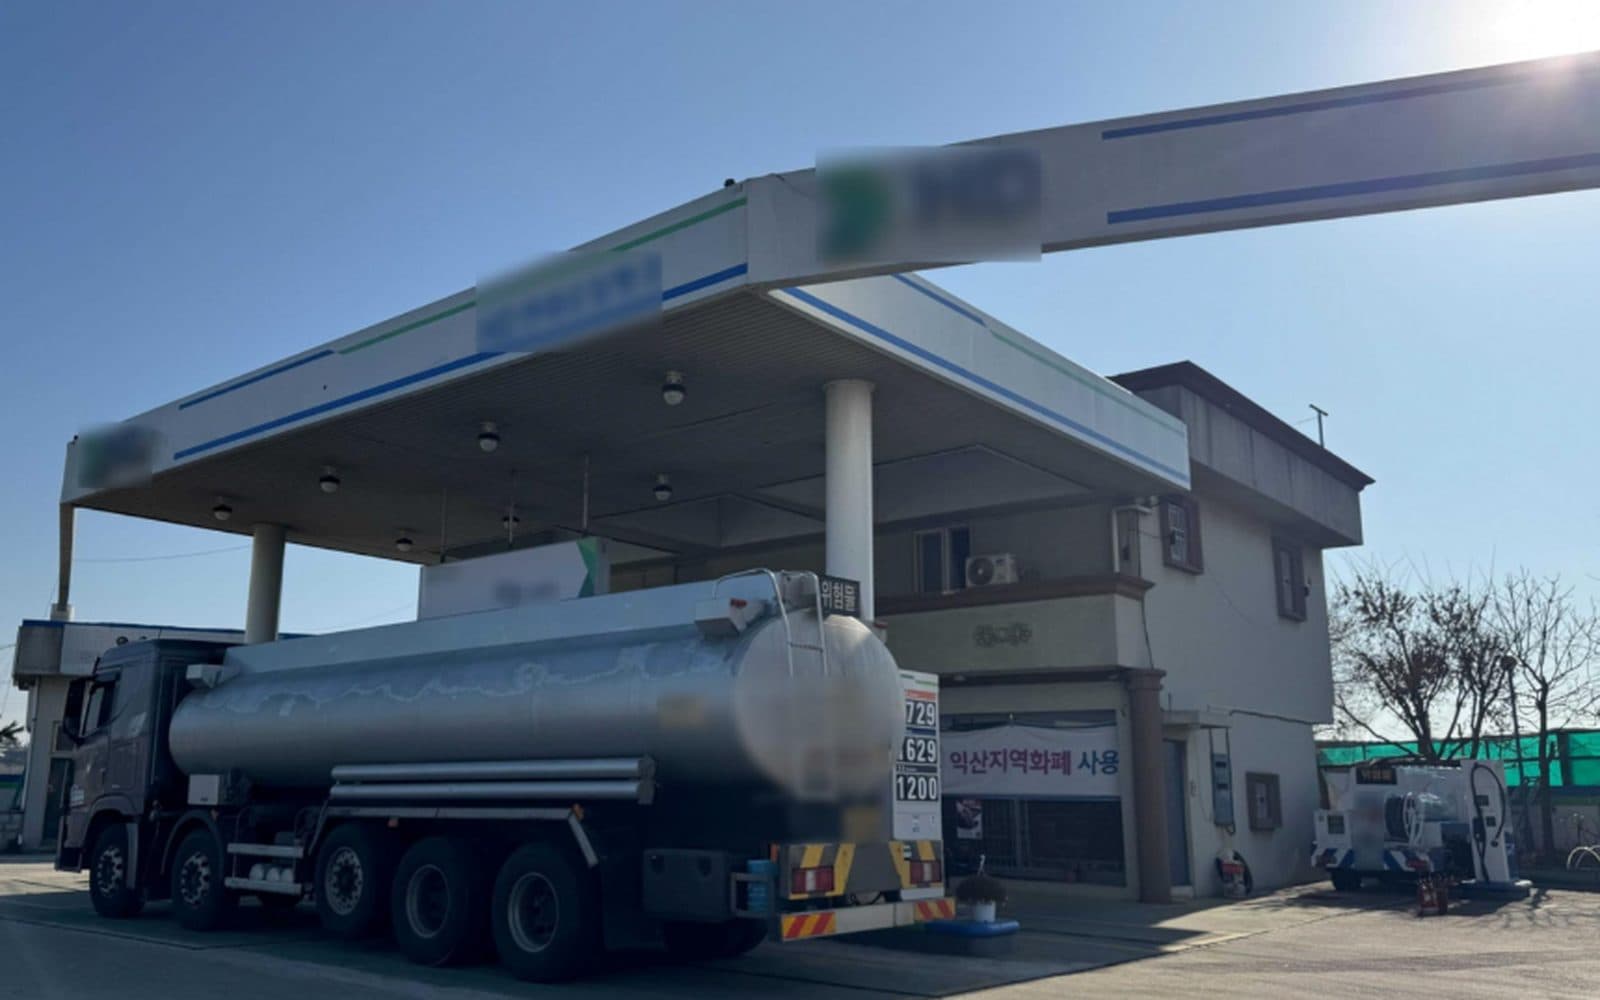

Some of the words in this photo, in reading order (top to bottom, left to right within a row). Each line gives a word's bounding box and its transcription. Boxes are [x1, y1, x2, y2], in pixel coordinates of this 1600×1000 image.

[822, 580, 856, 611] 위험물
[950, 748, 1071, 776] 익산지역화폐
[1078, 750, 1119, 775] 사용
[897, 776, 937, 800] 1200
